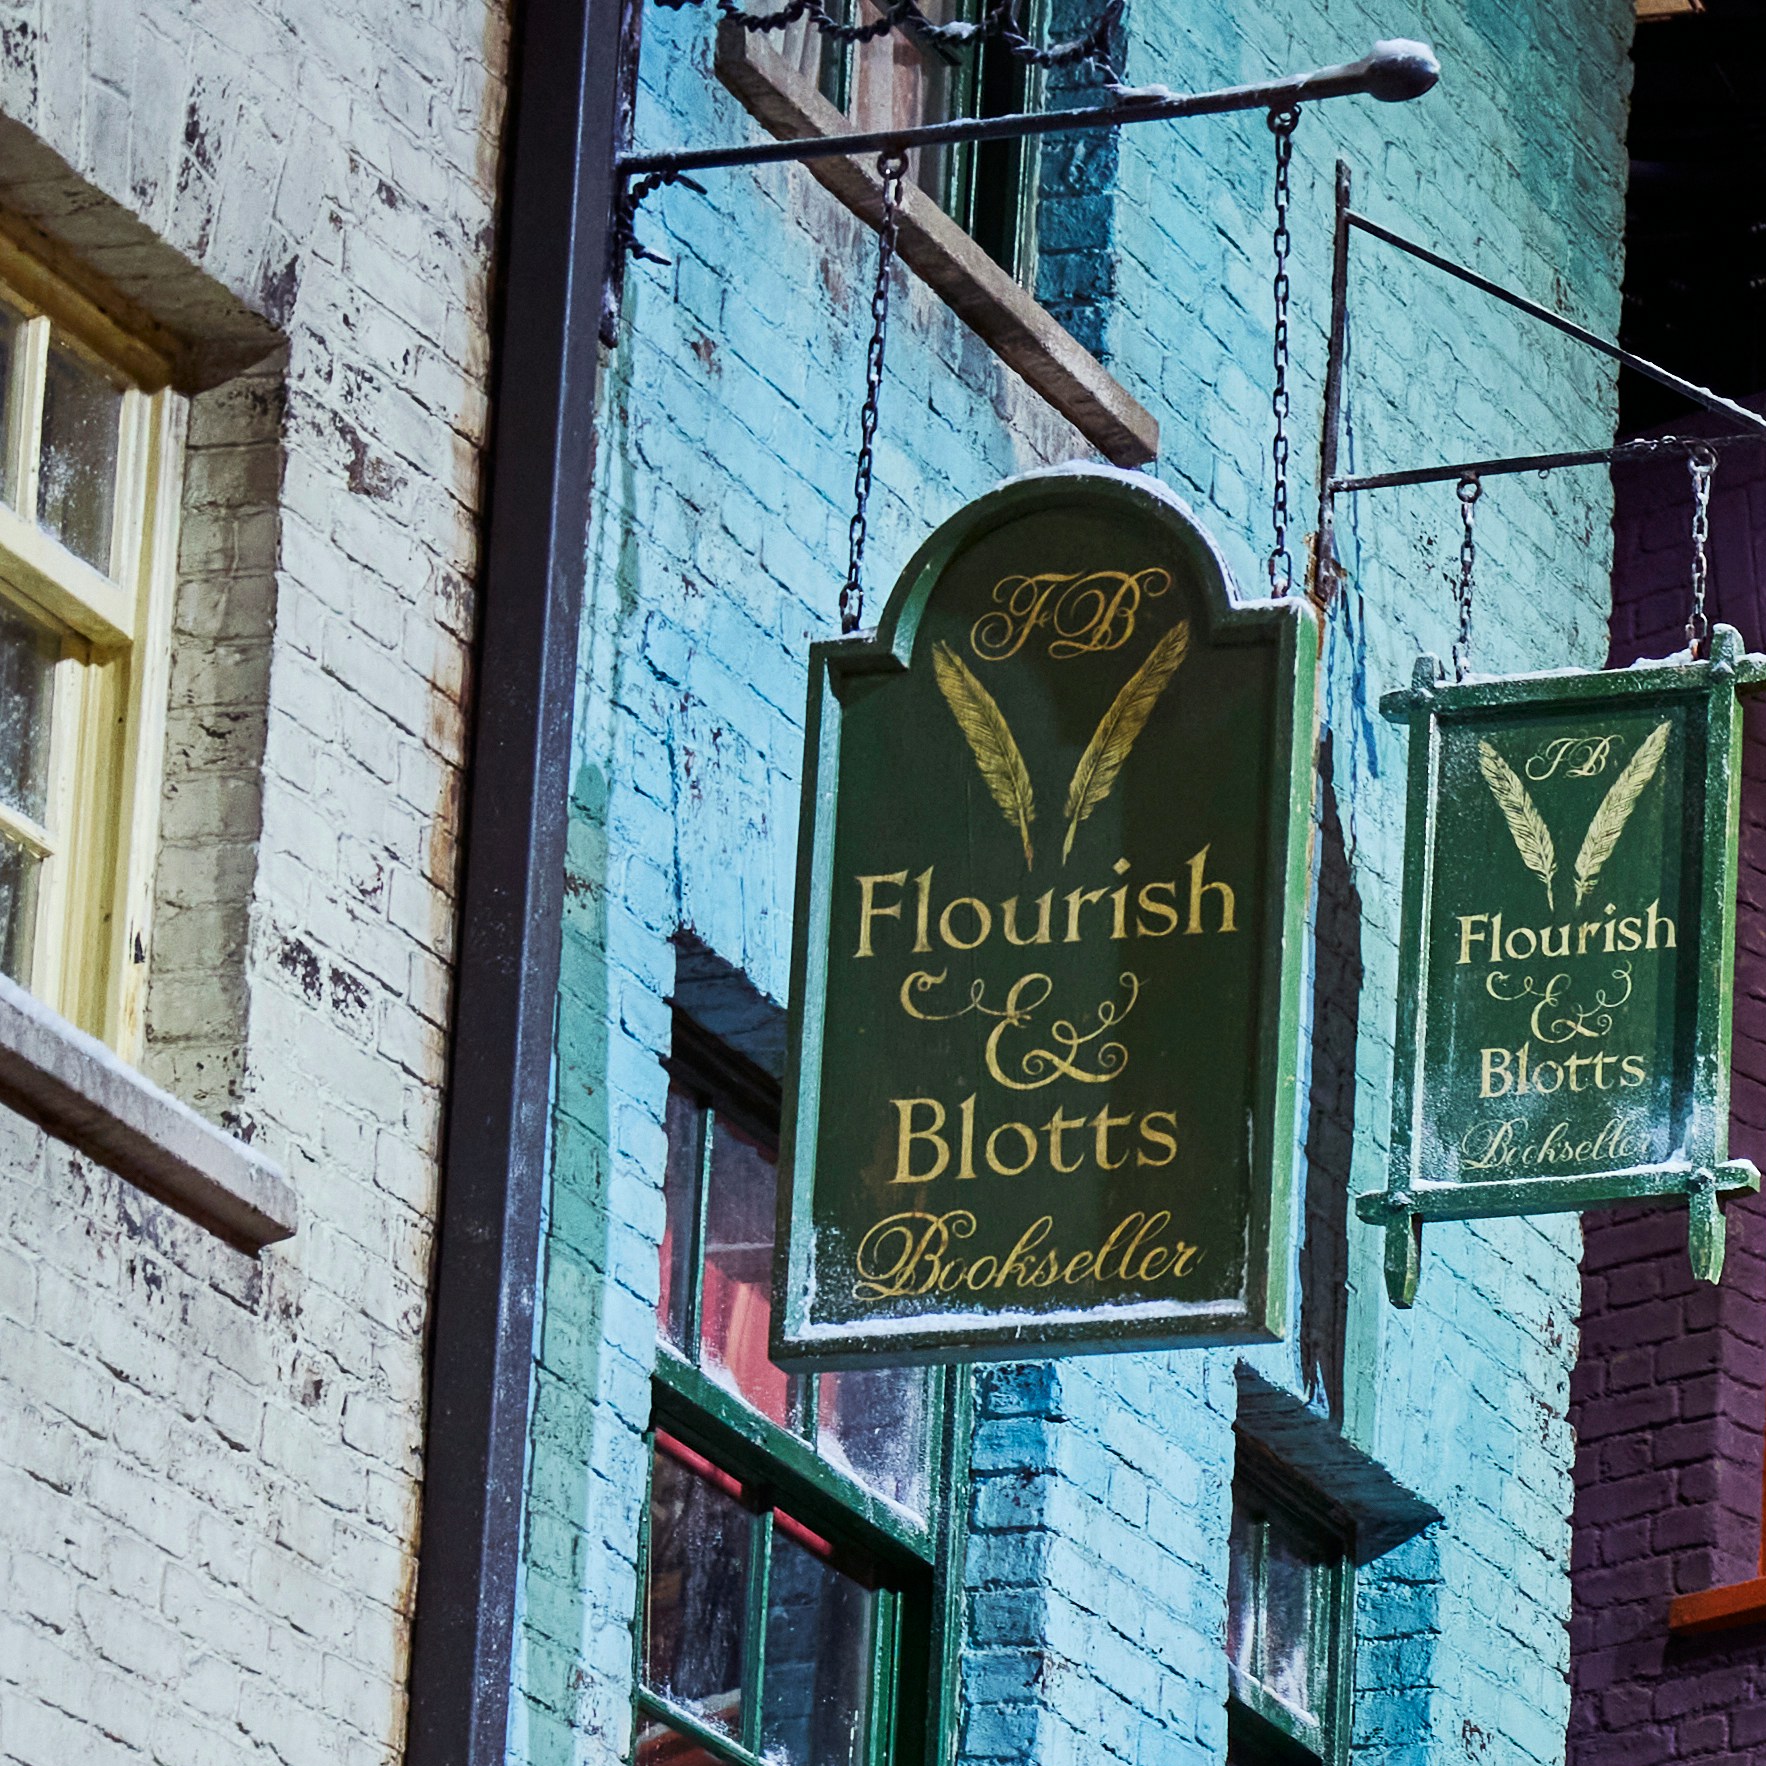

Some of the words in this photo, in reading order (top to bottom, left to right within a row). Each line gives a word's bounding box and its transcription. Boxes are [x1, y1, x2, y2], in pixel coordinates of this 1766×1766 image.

[852, 845, 1239, 959] Flourish
[1455, 897, 1677, 964] Flourish
[900, 971, 1150, 1090] &
[1486, 960, 1633, 1044] &
[1478, 1041, 1647, 1099] Blotts
[888, 1092, 1179, 1184] Blotts
[851, 1209, 1206, 1301] Bookseller
